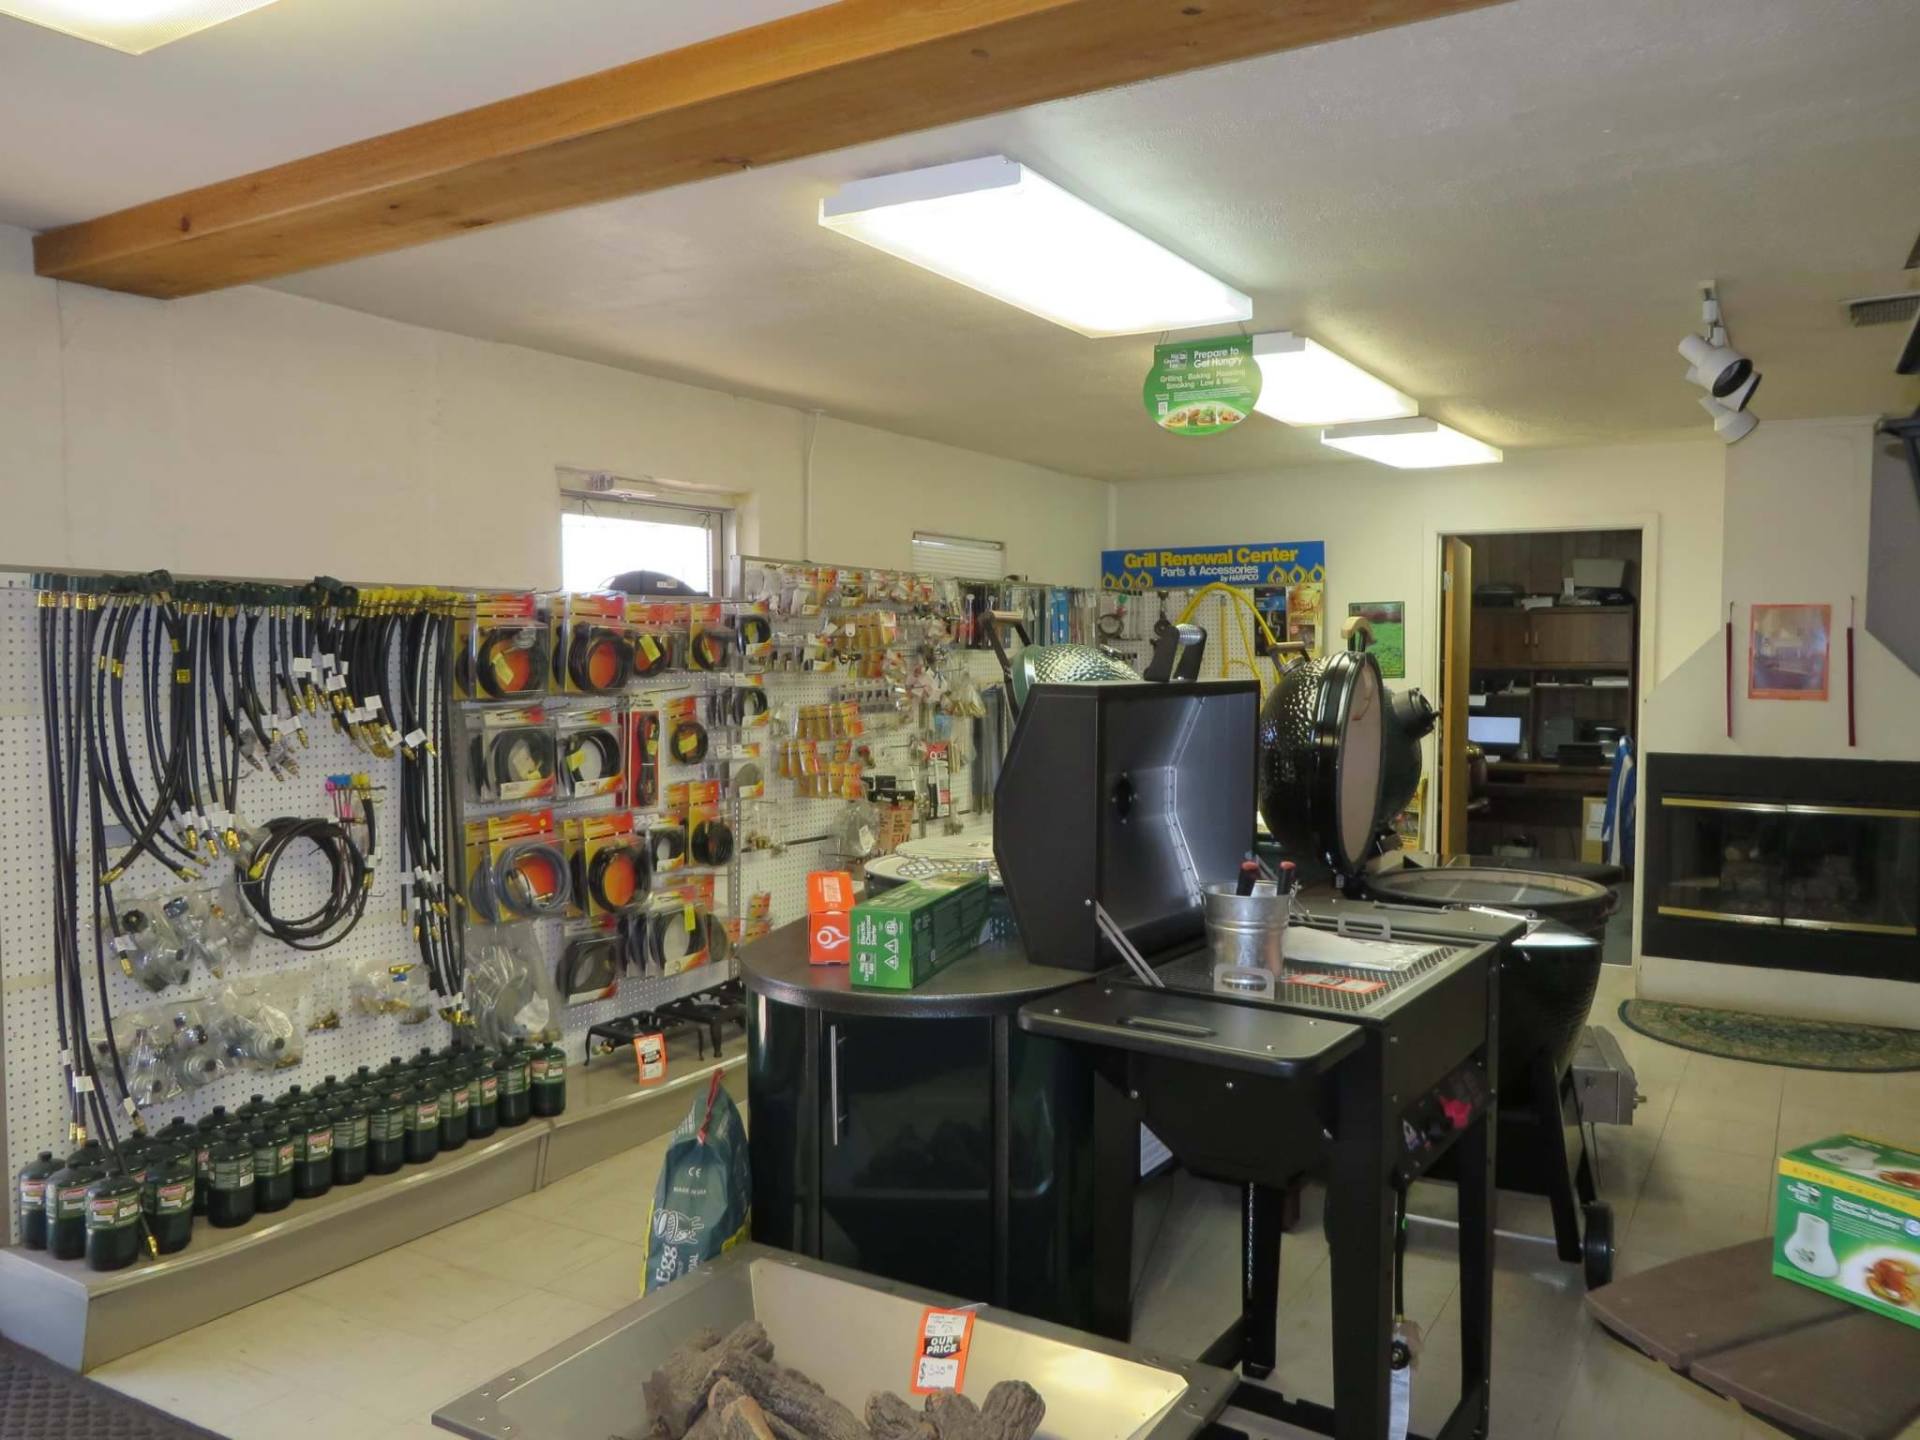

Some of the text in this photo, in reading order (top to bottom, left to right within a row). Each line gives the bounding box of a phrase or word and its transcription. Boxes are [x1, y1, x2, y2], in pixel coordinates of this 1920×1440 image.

[1194, 347, 1240, 360] Prepare to
[1193, 356, 1244, 369] Get Hungry
[1124, 547, 1299, 569] Grill Renewal Center
[1160, 564, 1259, 577] Parts & Accessories
[656, 1243, 678, 1282] Egg
[931, 1335, 954, 1346] OUR
[926, 1344, 958, 1355] PRICE
